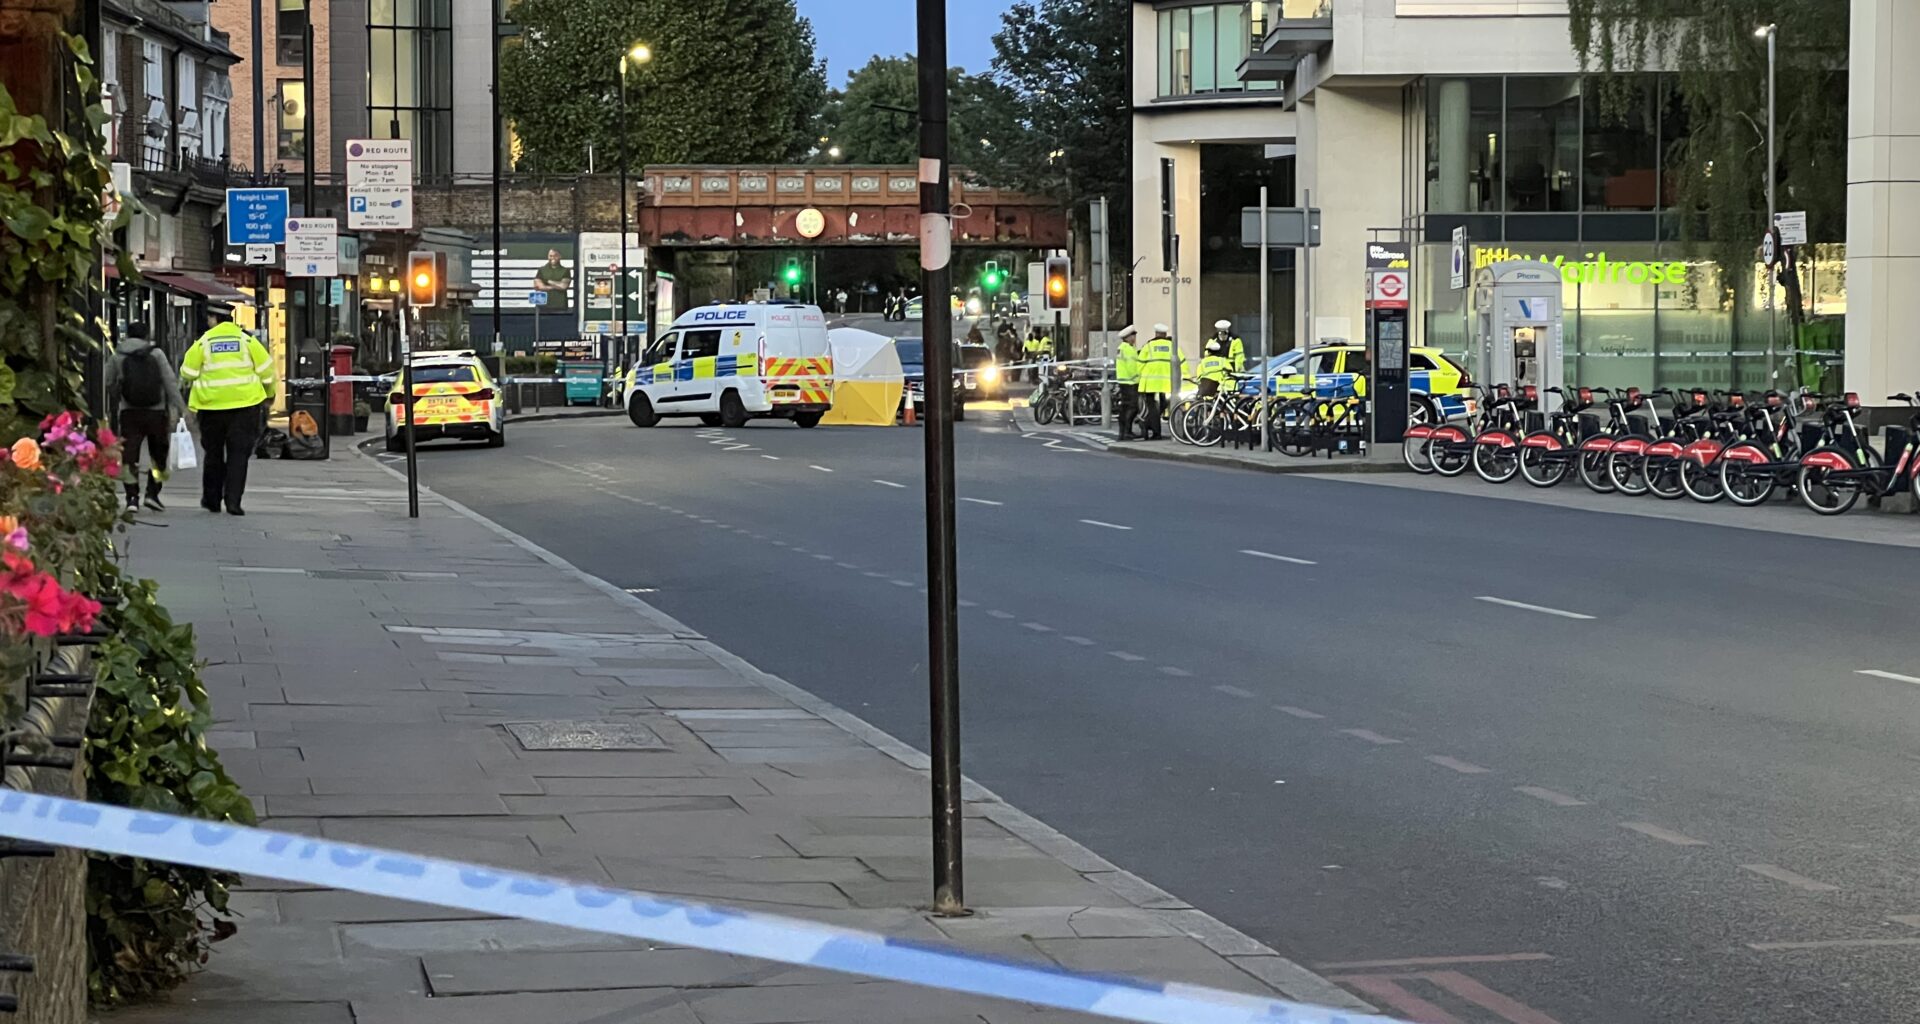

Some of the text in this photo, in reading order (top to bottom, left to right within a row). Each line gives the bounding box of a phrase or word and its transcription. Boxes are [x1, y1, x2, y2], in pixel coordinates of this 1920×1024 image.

[236, 194, 260, 202] Height
[260, 223, 272, 231] yds
[1764, 241, 1772, 256] 20
[1140, 276, 1192, 284] STAMFOD SQ
[1516, 272, 1540, 280] Phone
[694, 310, 747, 321] POLICE
[211, 343, 239, 352] POLICE
